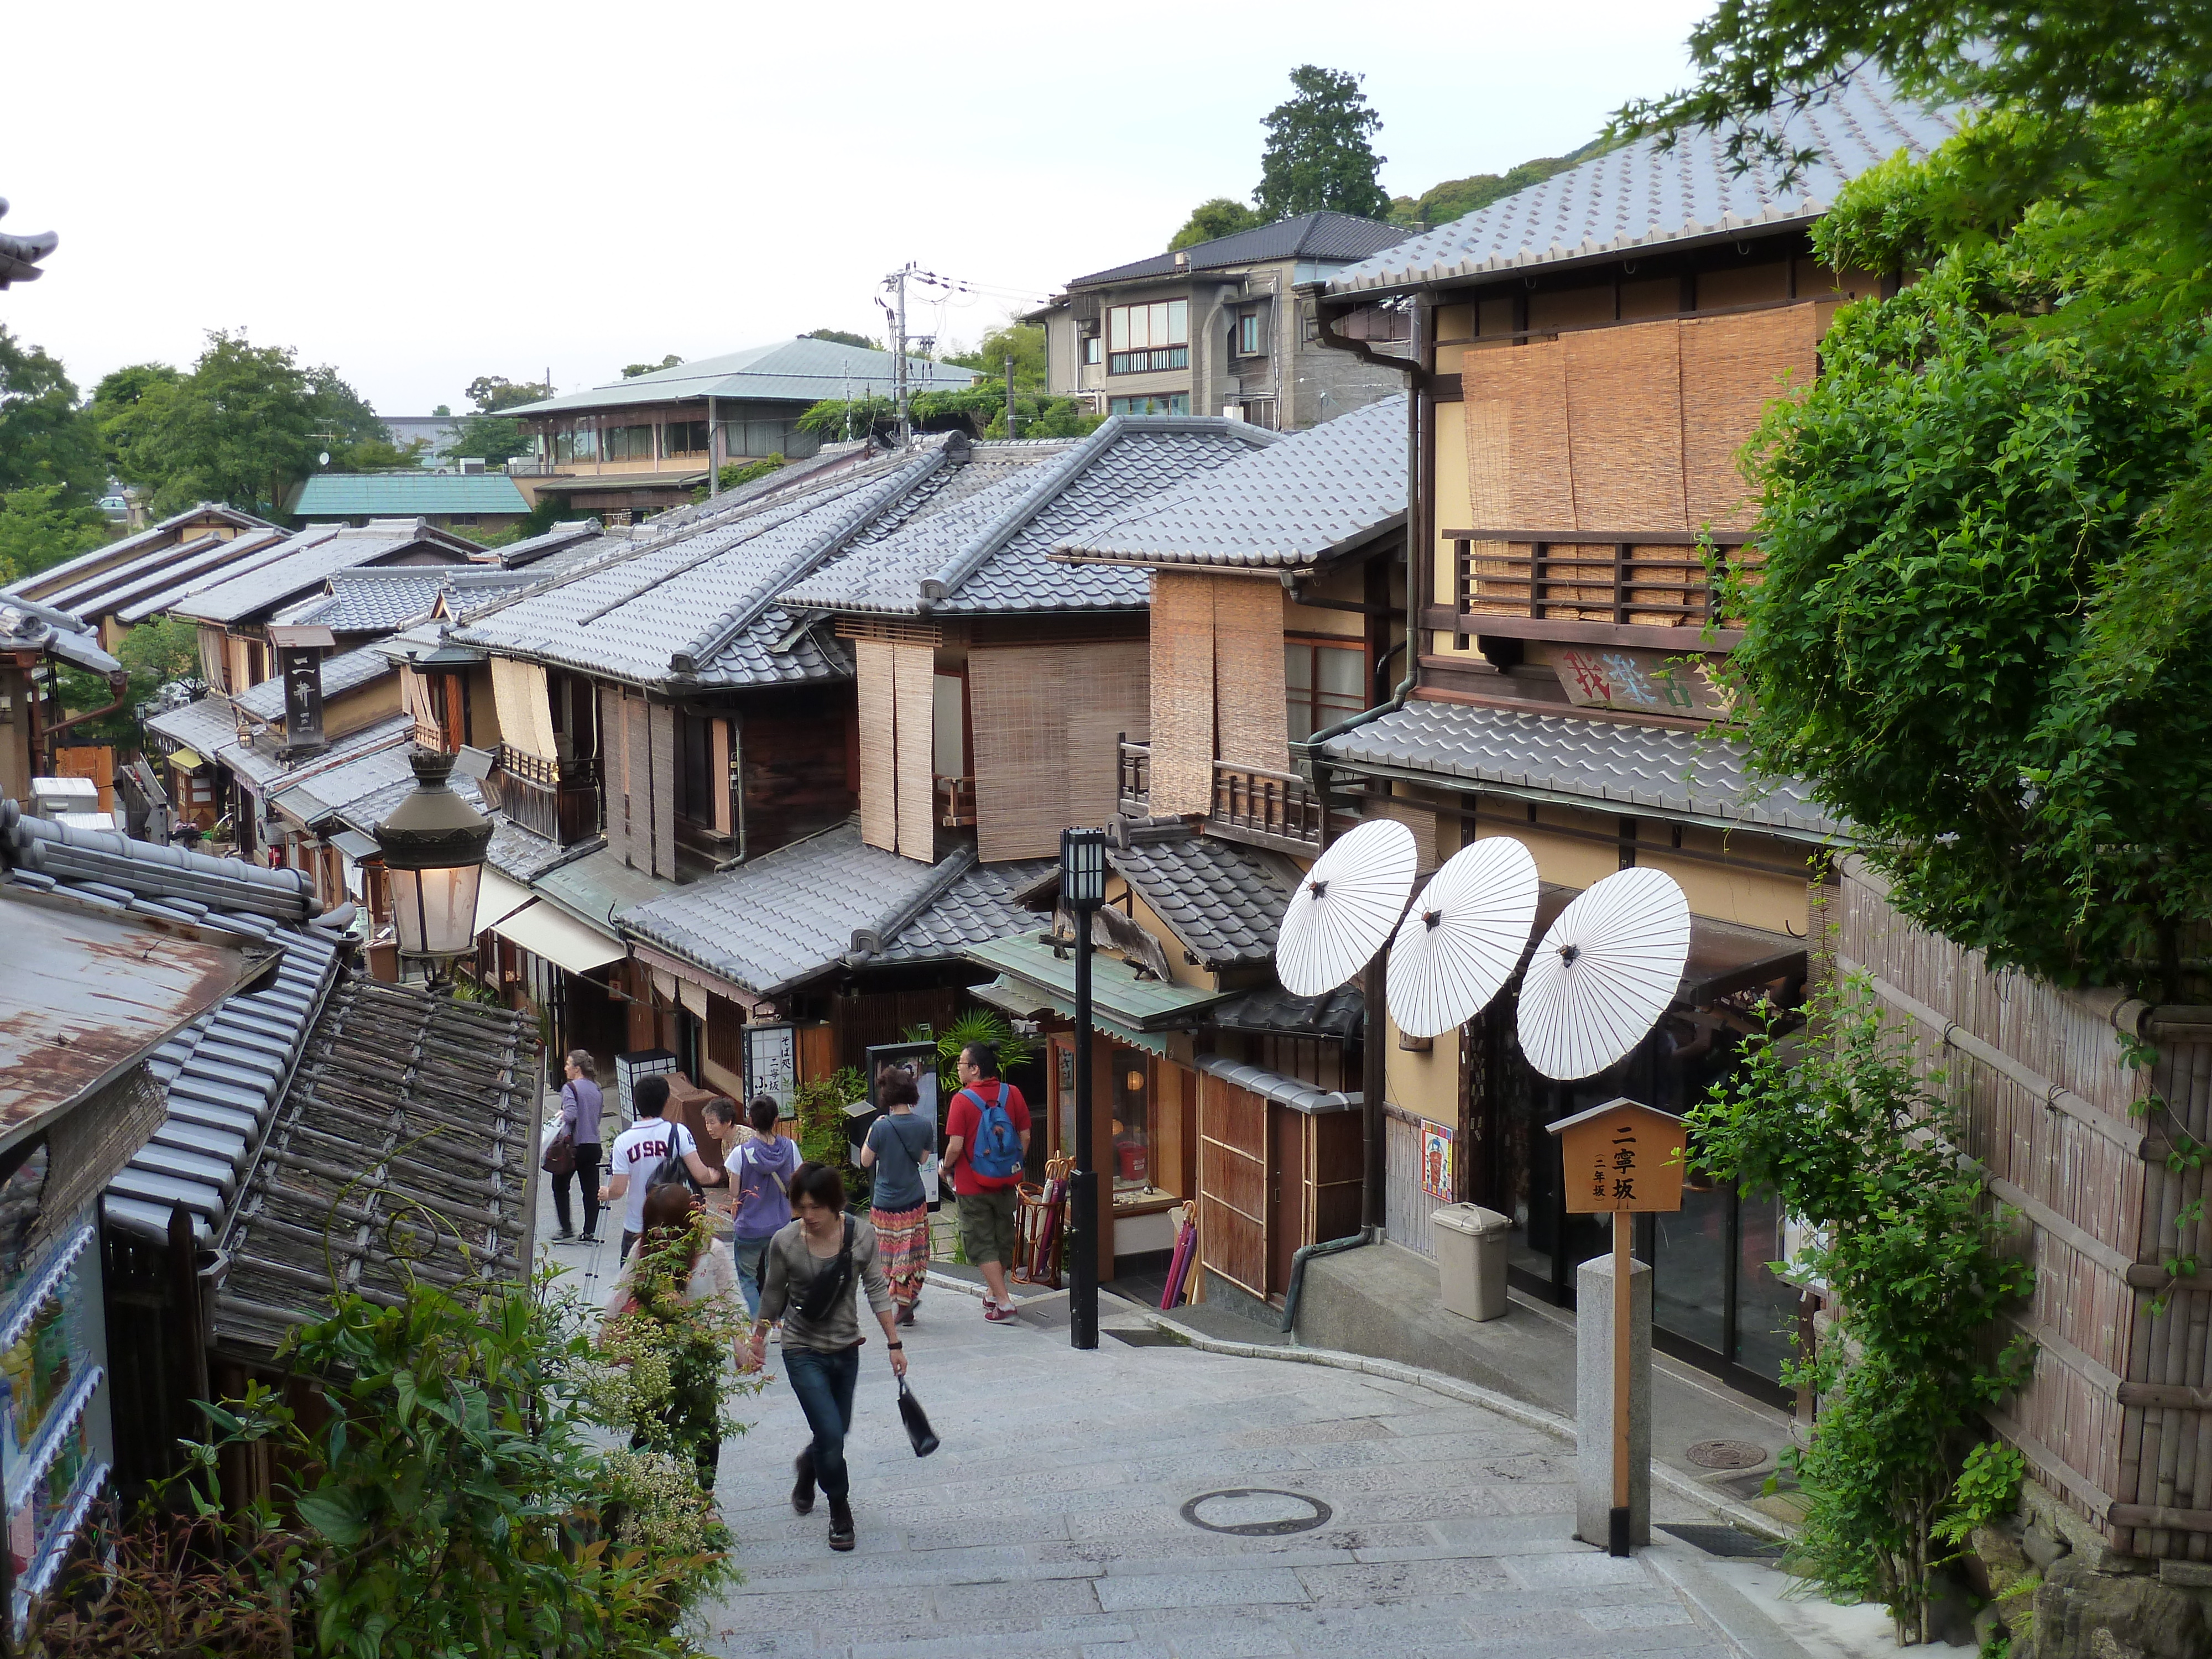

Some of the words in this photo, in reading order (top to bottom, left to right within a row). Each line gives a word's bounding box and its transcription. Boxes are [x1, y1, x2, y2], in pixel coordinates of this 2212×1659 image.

[781, 1036, 791, 1069] そば処
[769, 1058, 780, 1091] 二寧坂
[627, 1140, 668, 1164] USA
[1612, 1126, 1636, 1199] 二寧坂
